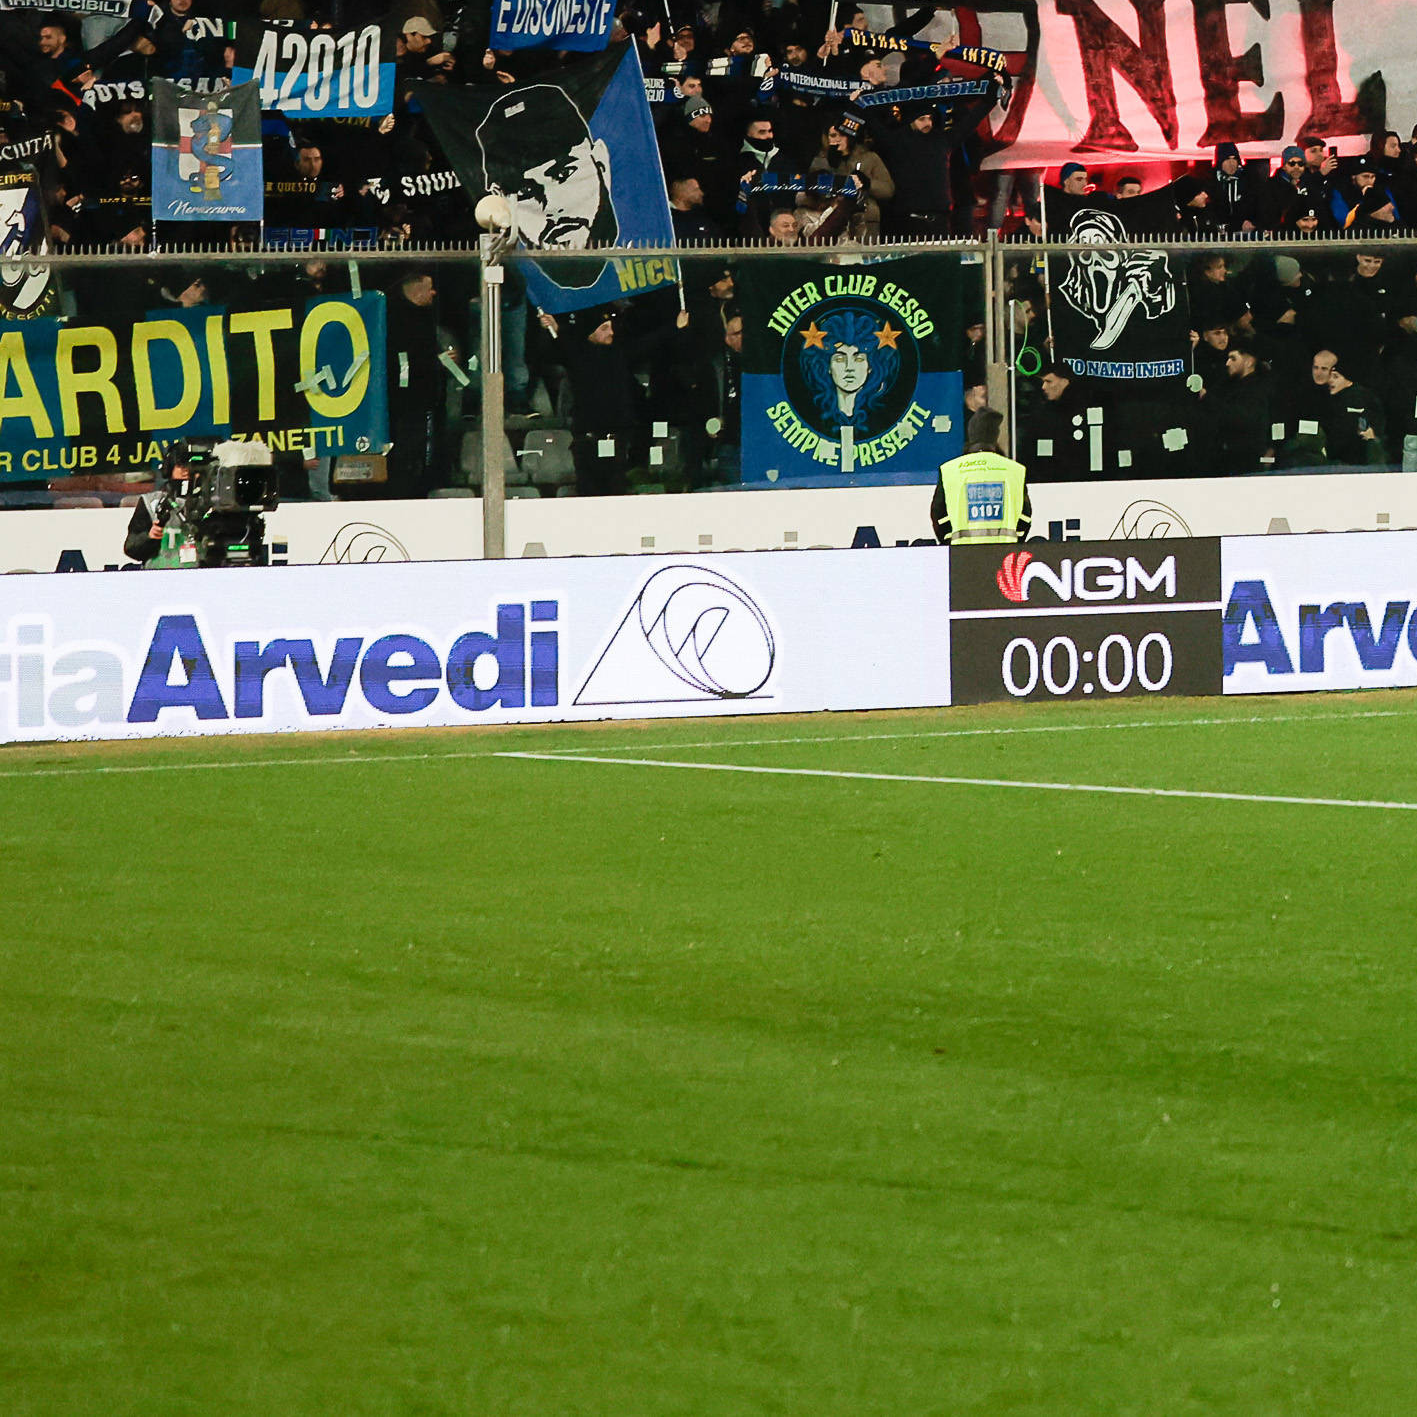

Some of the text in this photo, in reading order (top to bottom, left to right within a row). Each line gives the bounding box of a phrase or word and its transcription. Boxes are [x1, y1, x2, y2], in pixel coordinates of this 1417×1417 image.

[252, 23, 382, 111] 42010
[852, 28, 1008, 71] ULTRAS INTER
[790, 72, 848, 90] INTERNAZIONALE
[0, 134, 53, 162] CIUTA
[168, 198, 248, 215] Nerazzurra
[278, 181, 317, 195] QUESTO
[767, 273, 935, 340] INTER CLUB SESSO
[0, 301, 371, 439] ARDITO
[1087, 358, 1185, 379] NAME INTER
[765, 400, 842, 467] SEMPRE
[21, 444, 99, 472] CLUB
[106, 444, 121, 466] 4
[1021, 554, 1177, 602] NGM
[126, 599, 560, 723] Arvedi
[1001, 631, 1175, 697] 00:00
